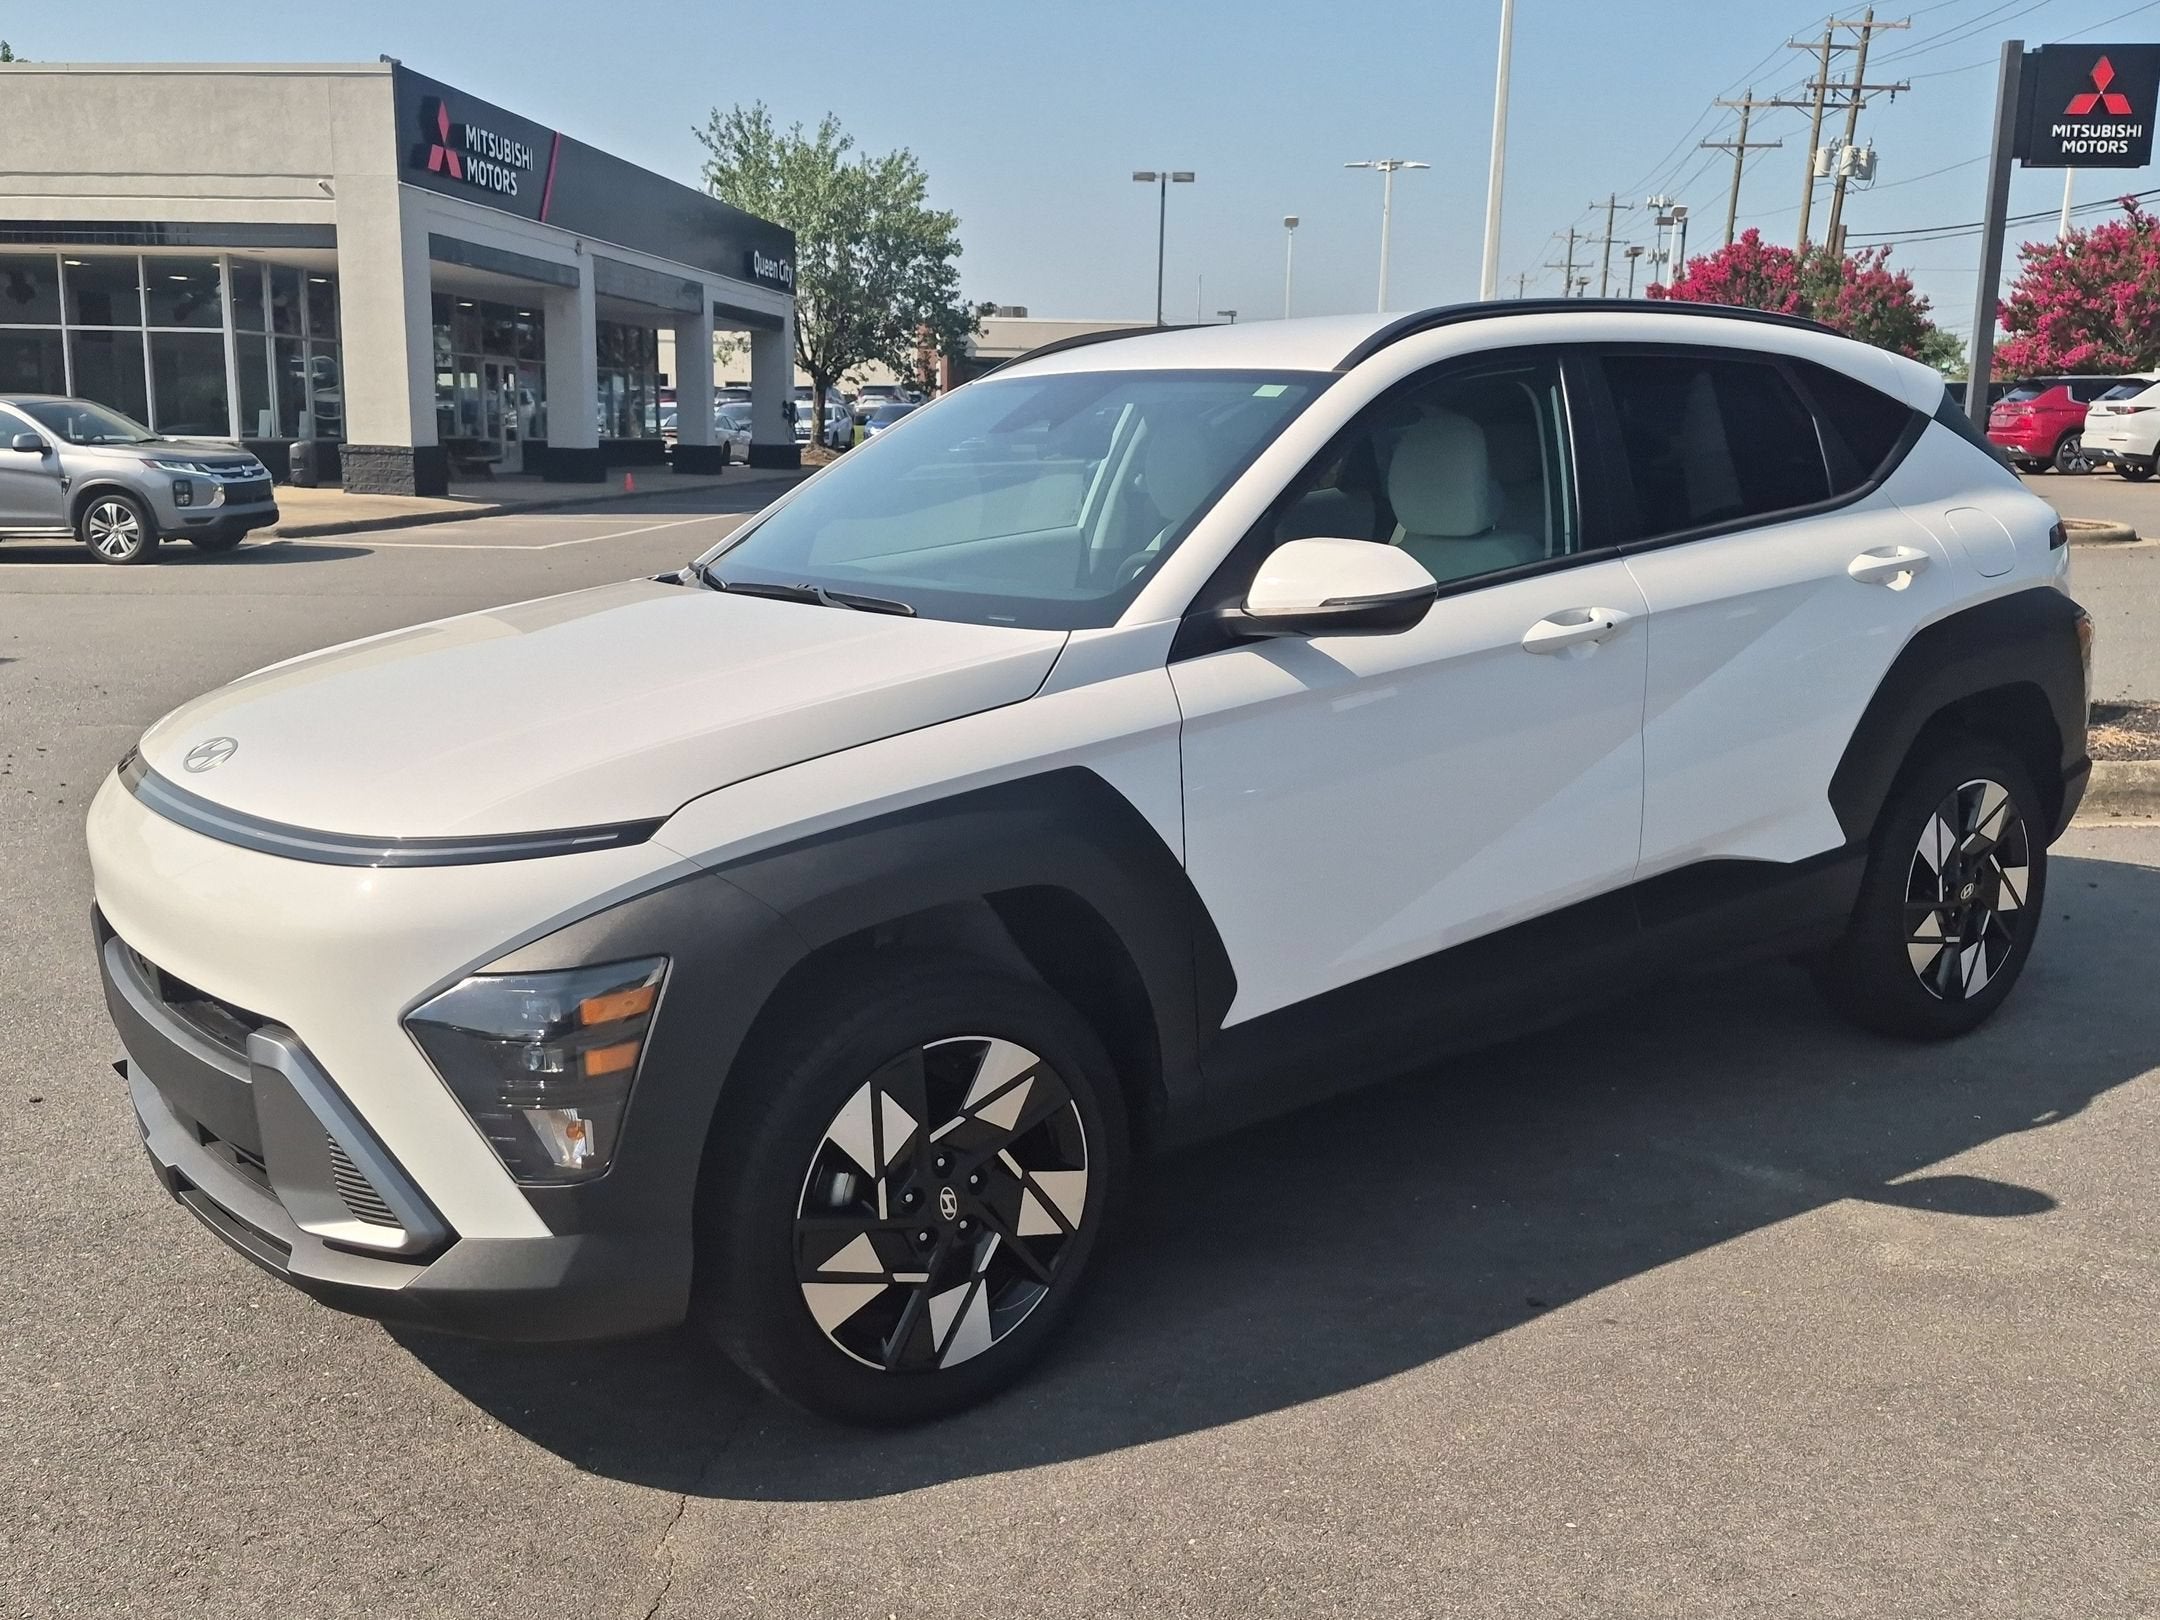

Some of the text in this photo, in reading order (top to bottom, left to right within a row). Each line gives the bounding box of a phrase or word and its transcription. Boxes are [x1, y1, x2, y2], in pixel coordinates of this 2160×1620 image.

[465, 123, 533, 171] MITSUBISHI
[2051, 124, 2143, 138] MITSUBISHI
[2061, 140, 2129, 154] MOTORS
[466, 156, 518, 196] MOTORS
[753, 249, 794, 289] Queen City
